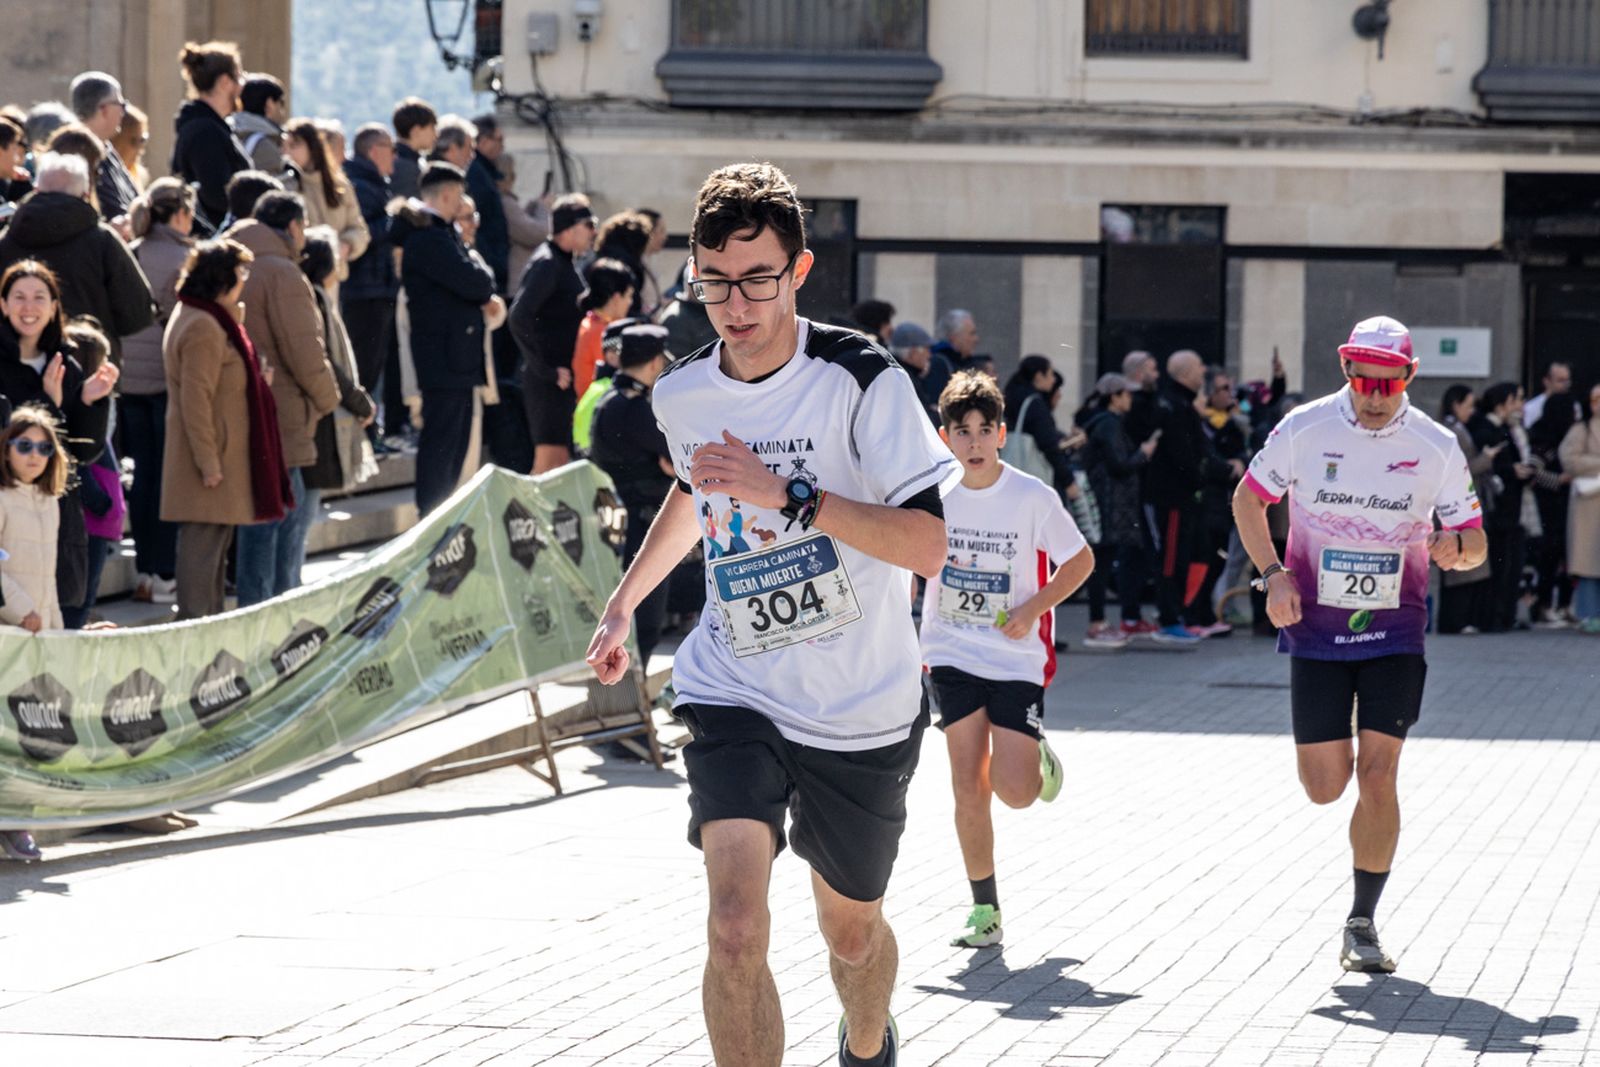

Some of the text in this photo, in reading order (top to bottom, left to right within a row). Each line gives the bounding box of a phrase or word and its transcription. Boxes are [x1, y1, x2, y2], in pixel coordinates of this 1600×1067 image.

[1313, 489, 1353, 505] SIERRA
[1363, 493, 1413, 511] SEGURA
[947, 537, 1001, 555] ENA MUERTE
[733, 557, 770, 576] CARRERA
[770, 543, 819, 567] CAMINATA
[1353, 562, 1380, 573] MUERTE
[729, 563, 804, 596] BUENA MUERTE
[1345, 573, 1376, 596] 20
[747, 580, 825, 633] 304
[958, 591, 985, 612] 29
[753, 626, 784, 641] FRANCISCO
